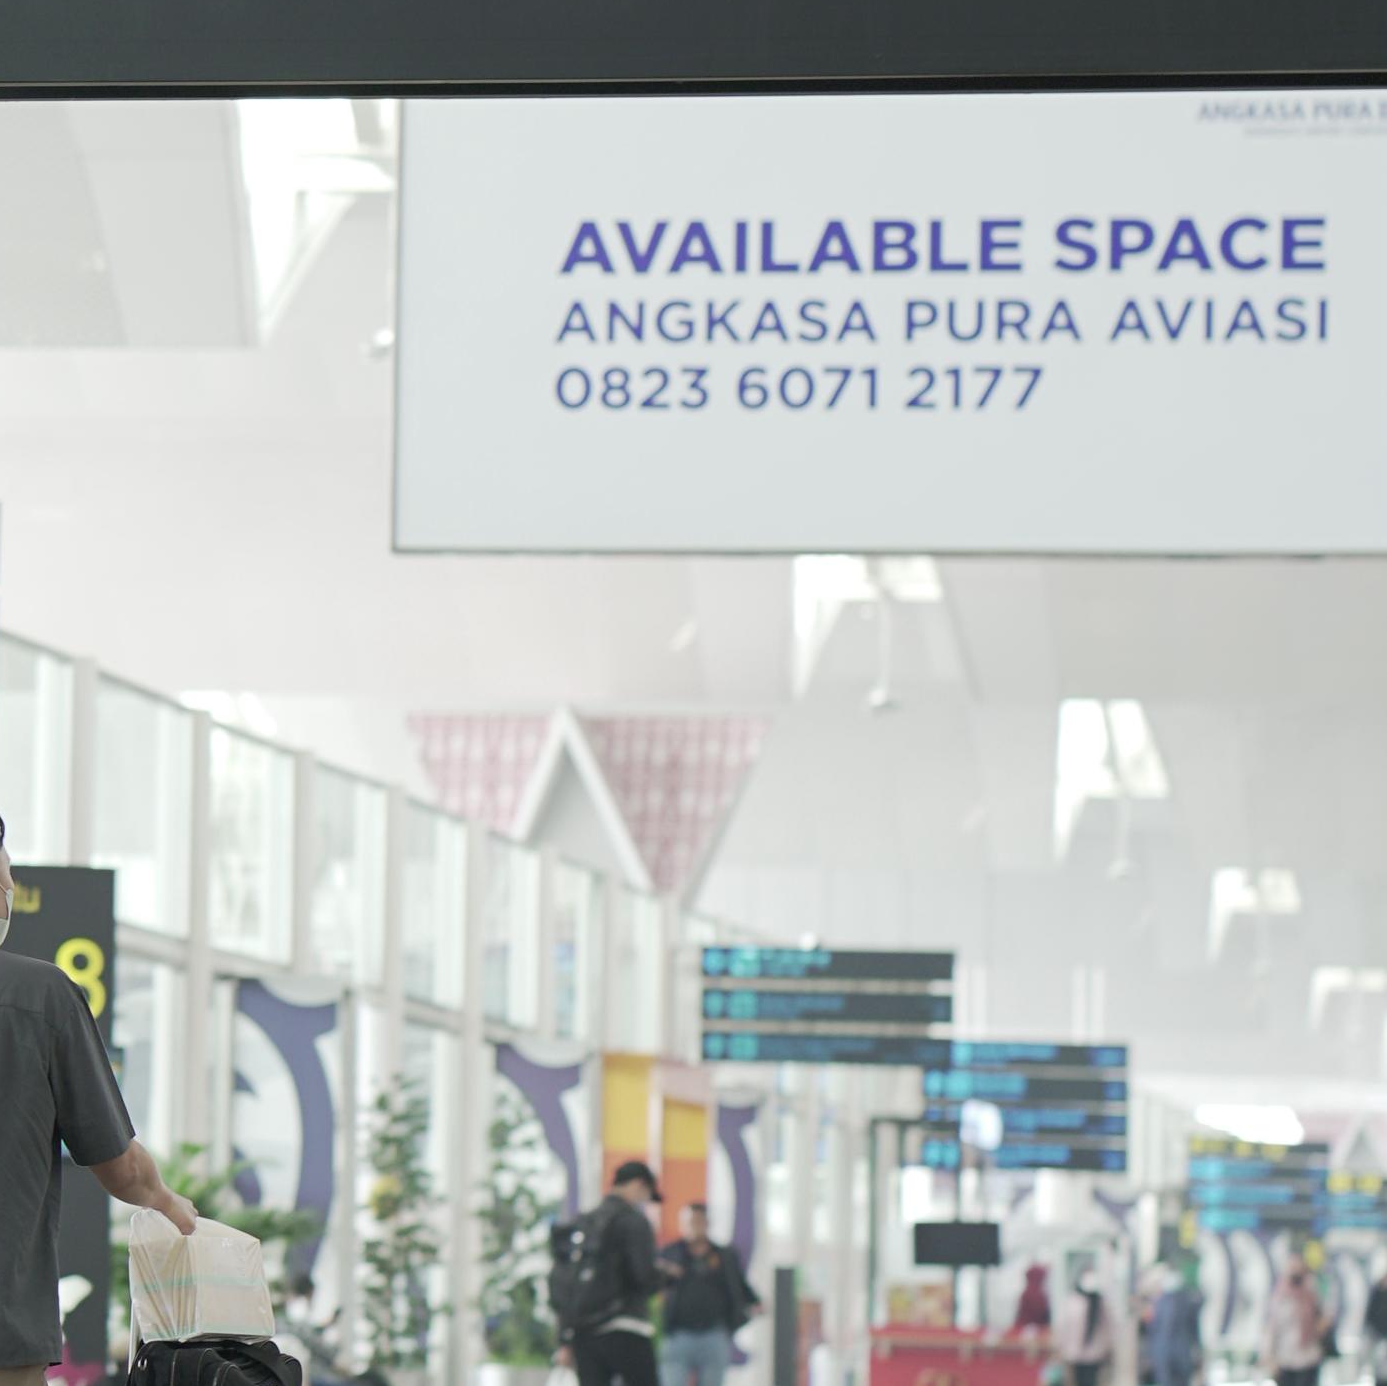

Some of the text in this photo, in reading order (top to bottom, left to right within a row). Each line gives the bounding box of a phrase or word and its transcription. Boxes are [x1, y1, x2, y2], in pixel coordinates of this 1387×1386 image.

[559, 217, 1327, 275] AVAILABLE SPACE
[556, 297, 1329, 344] ANGKASA PURA AVIASI
[555, 365, 1044, 410] 0823 6071 2177
